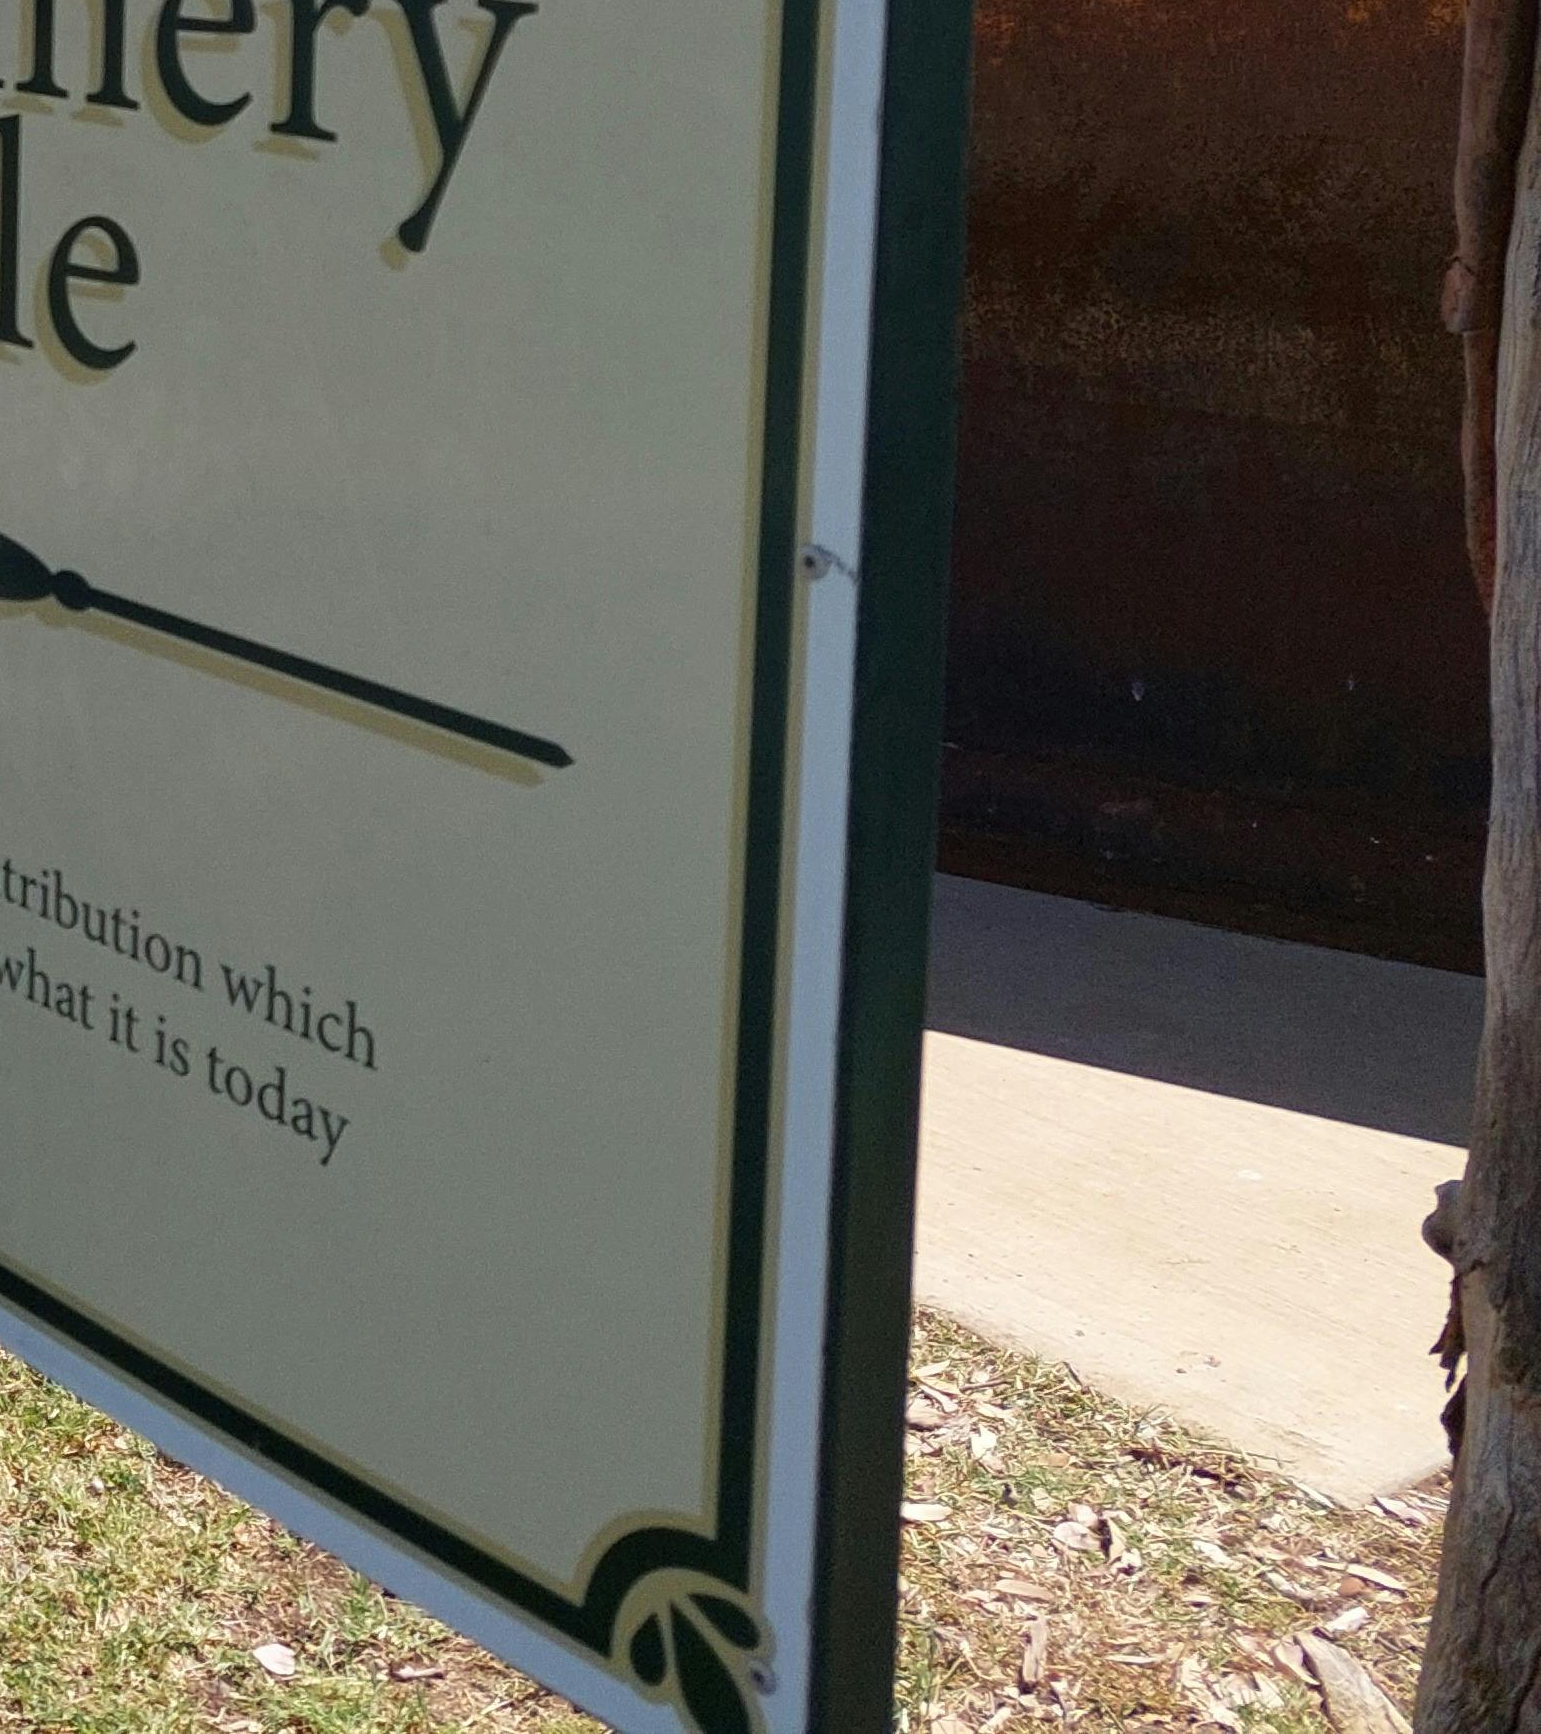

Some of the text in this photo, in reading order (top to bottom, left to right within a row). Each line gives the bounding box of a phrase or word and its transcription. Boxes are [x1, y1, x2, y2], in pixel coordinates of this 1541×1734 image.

[107, 993, 141, 1055] it
[152, 1016, 192, 1079] is
[205, 1045, 352, 1168] today
[218, 963, 378, 1072] which
